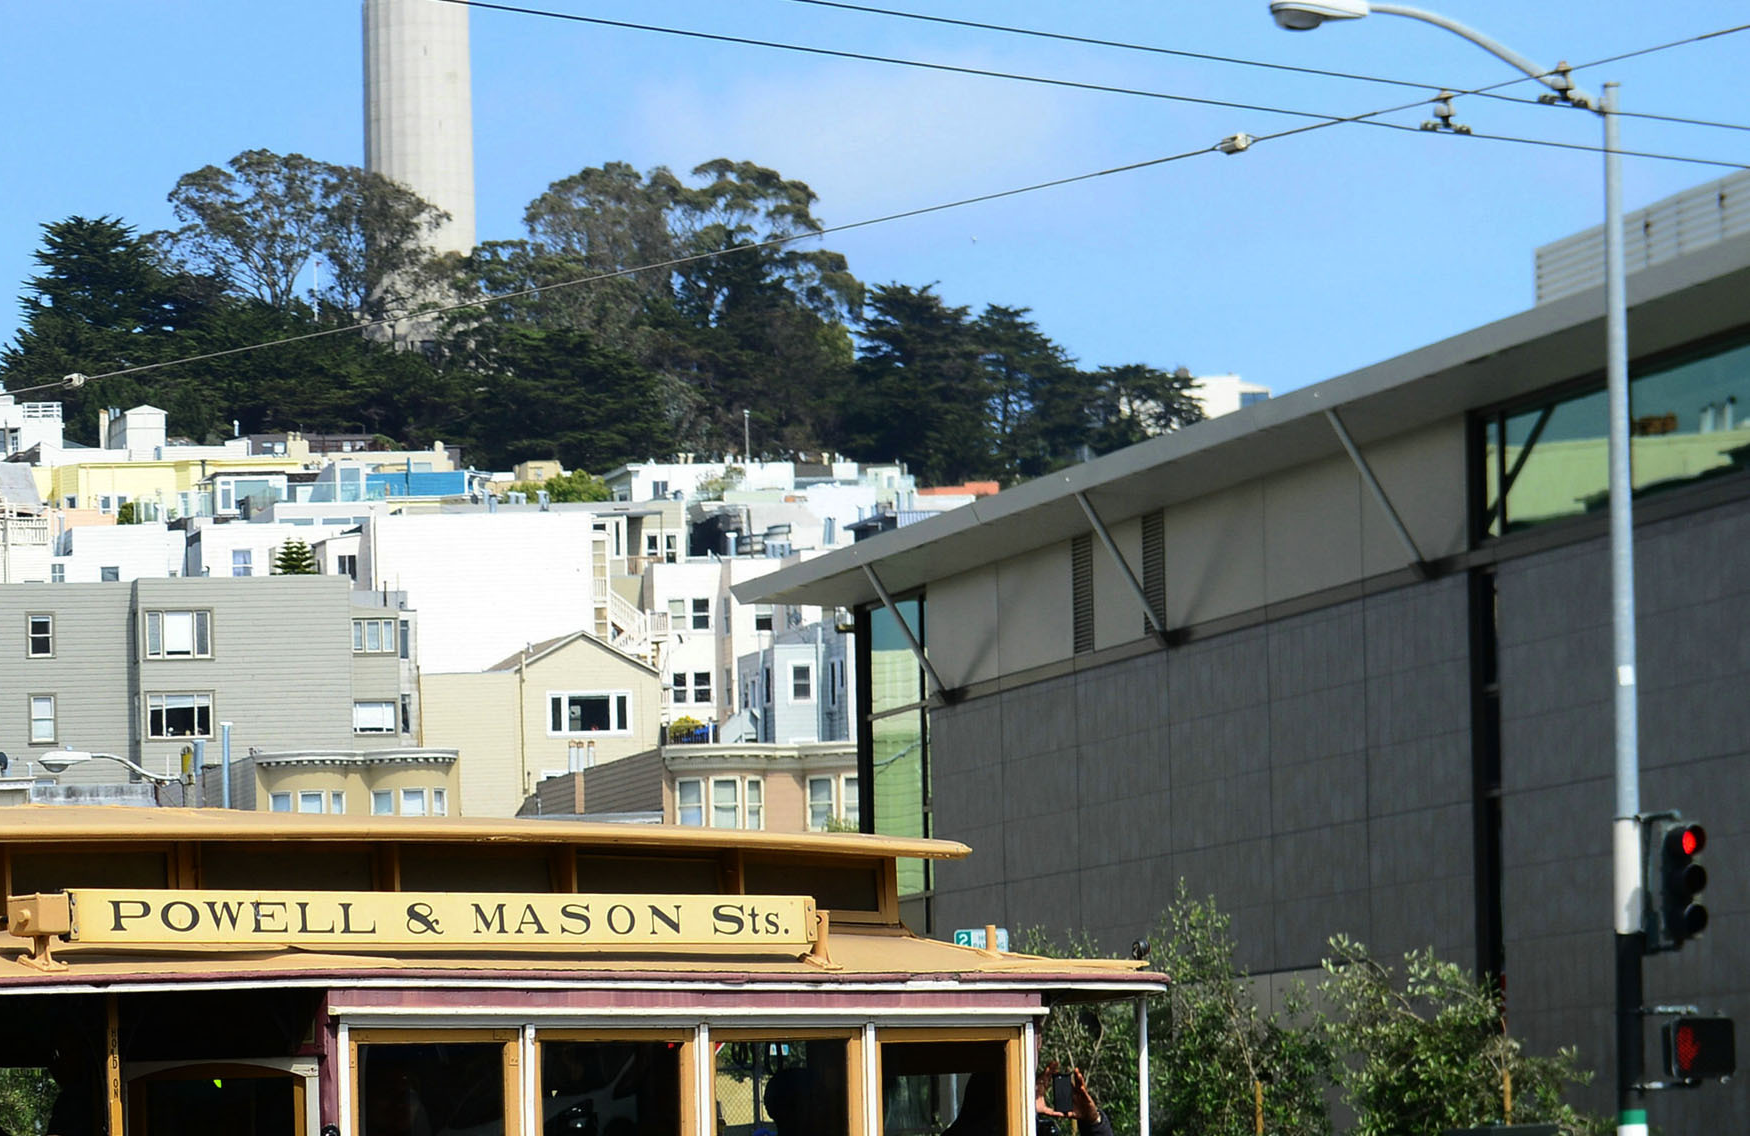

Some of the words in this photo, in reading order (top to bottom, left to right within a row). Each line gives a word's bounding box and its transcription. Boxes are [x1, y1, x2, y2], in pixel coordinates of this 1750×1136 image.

[110, 900, 377, 934] POWELL
[406, 902, 444, 934] &
[473, 902, 683, 936] MASON
[712, 903, 791, 936] Sts.
[113, 1078, 118, 1098] ON
